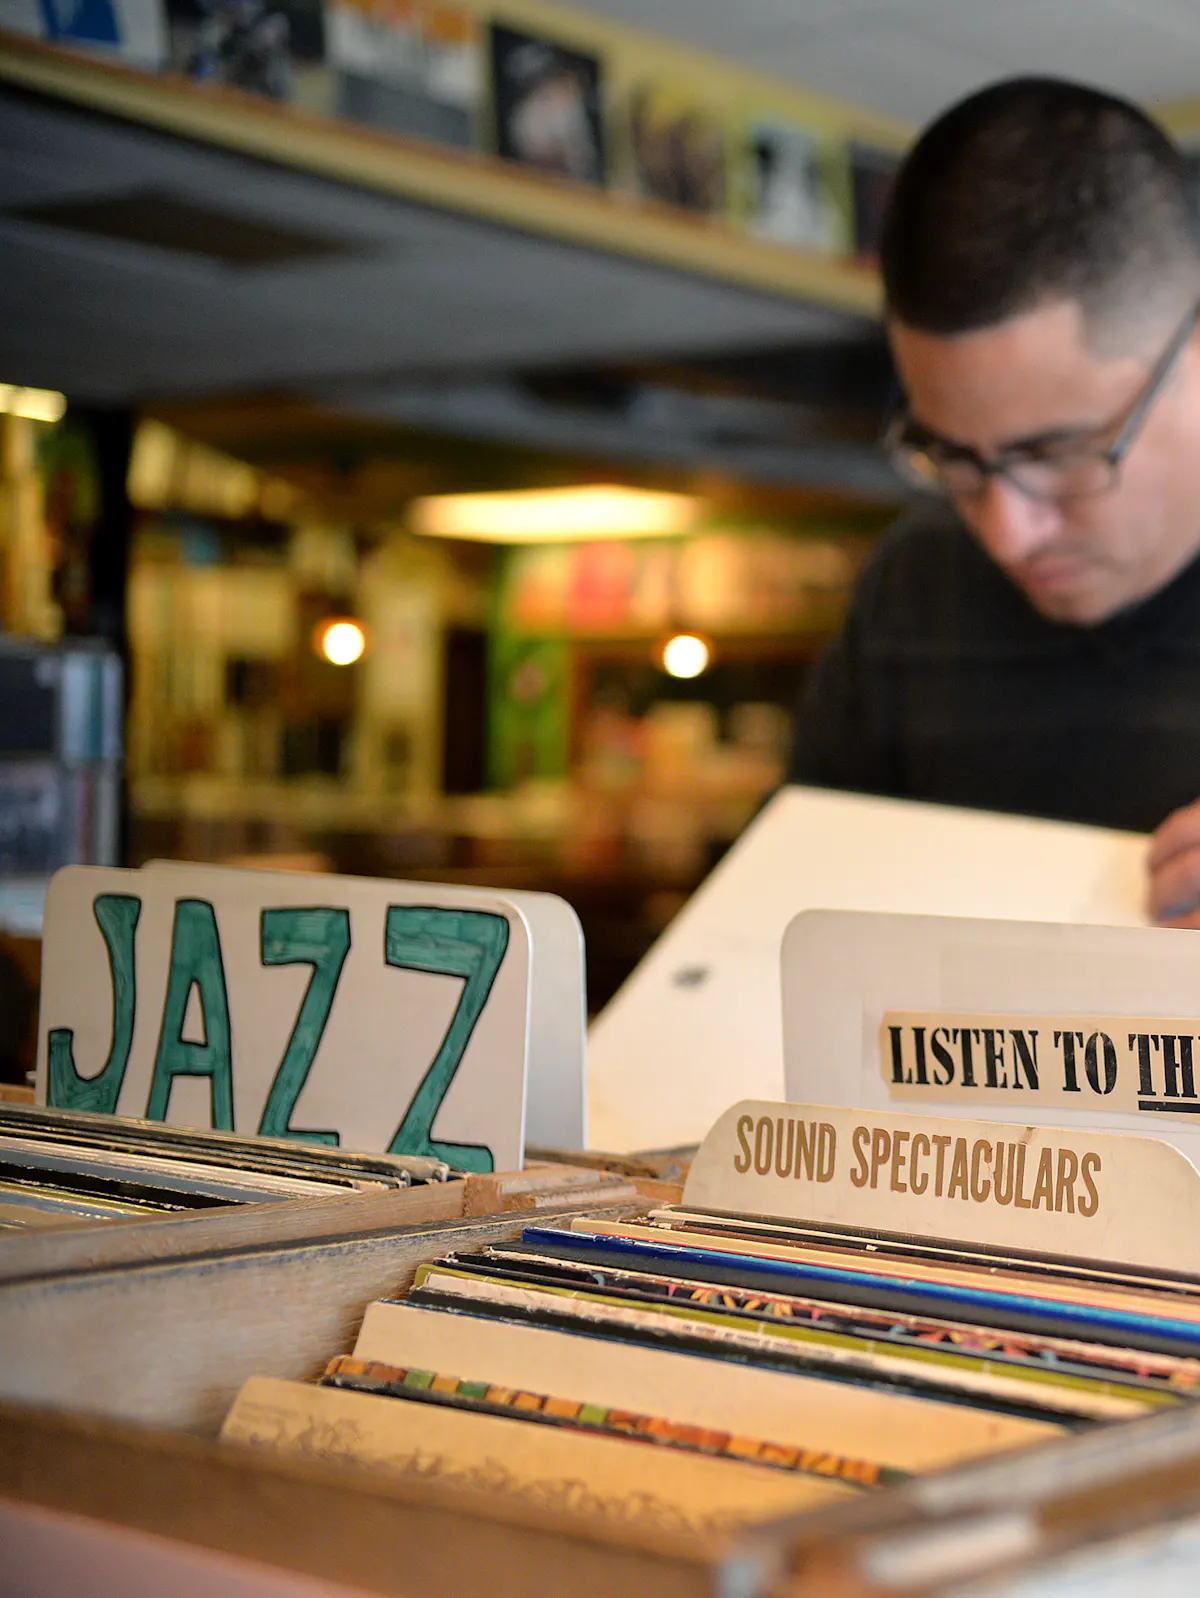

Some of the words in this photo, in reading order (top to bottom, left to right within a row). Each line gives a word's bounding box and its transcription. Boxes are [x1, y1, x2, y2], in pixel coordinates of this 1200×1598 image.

[47, 893, 511, 1173] JAZZ
[887, 1025, 1040, 1090] LISTEN
[1053, 1030, 1119, 1095] TO
[733, 1114, 836, 1183] SOUND
[849, 1125, 1102, 1218] SPECTACULARS
